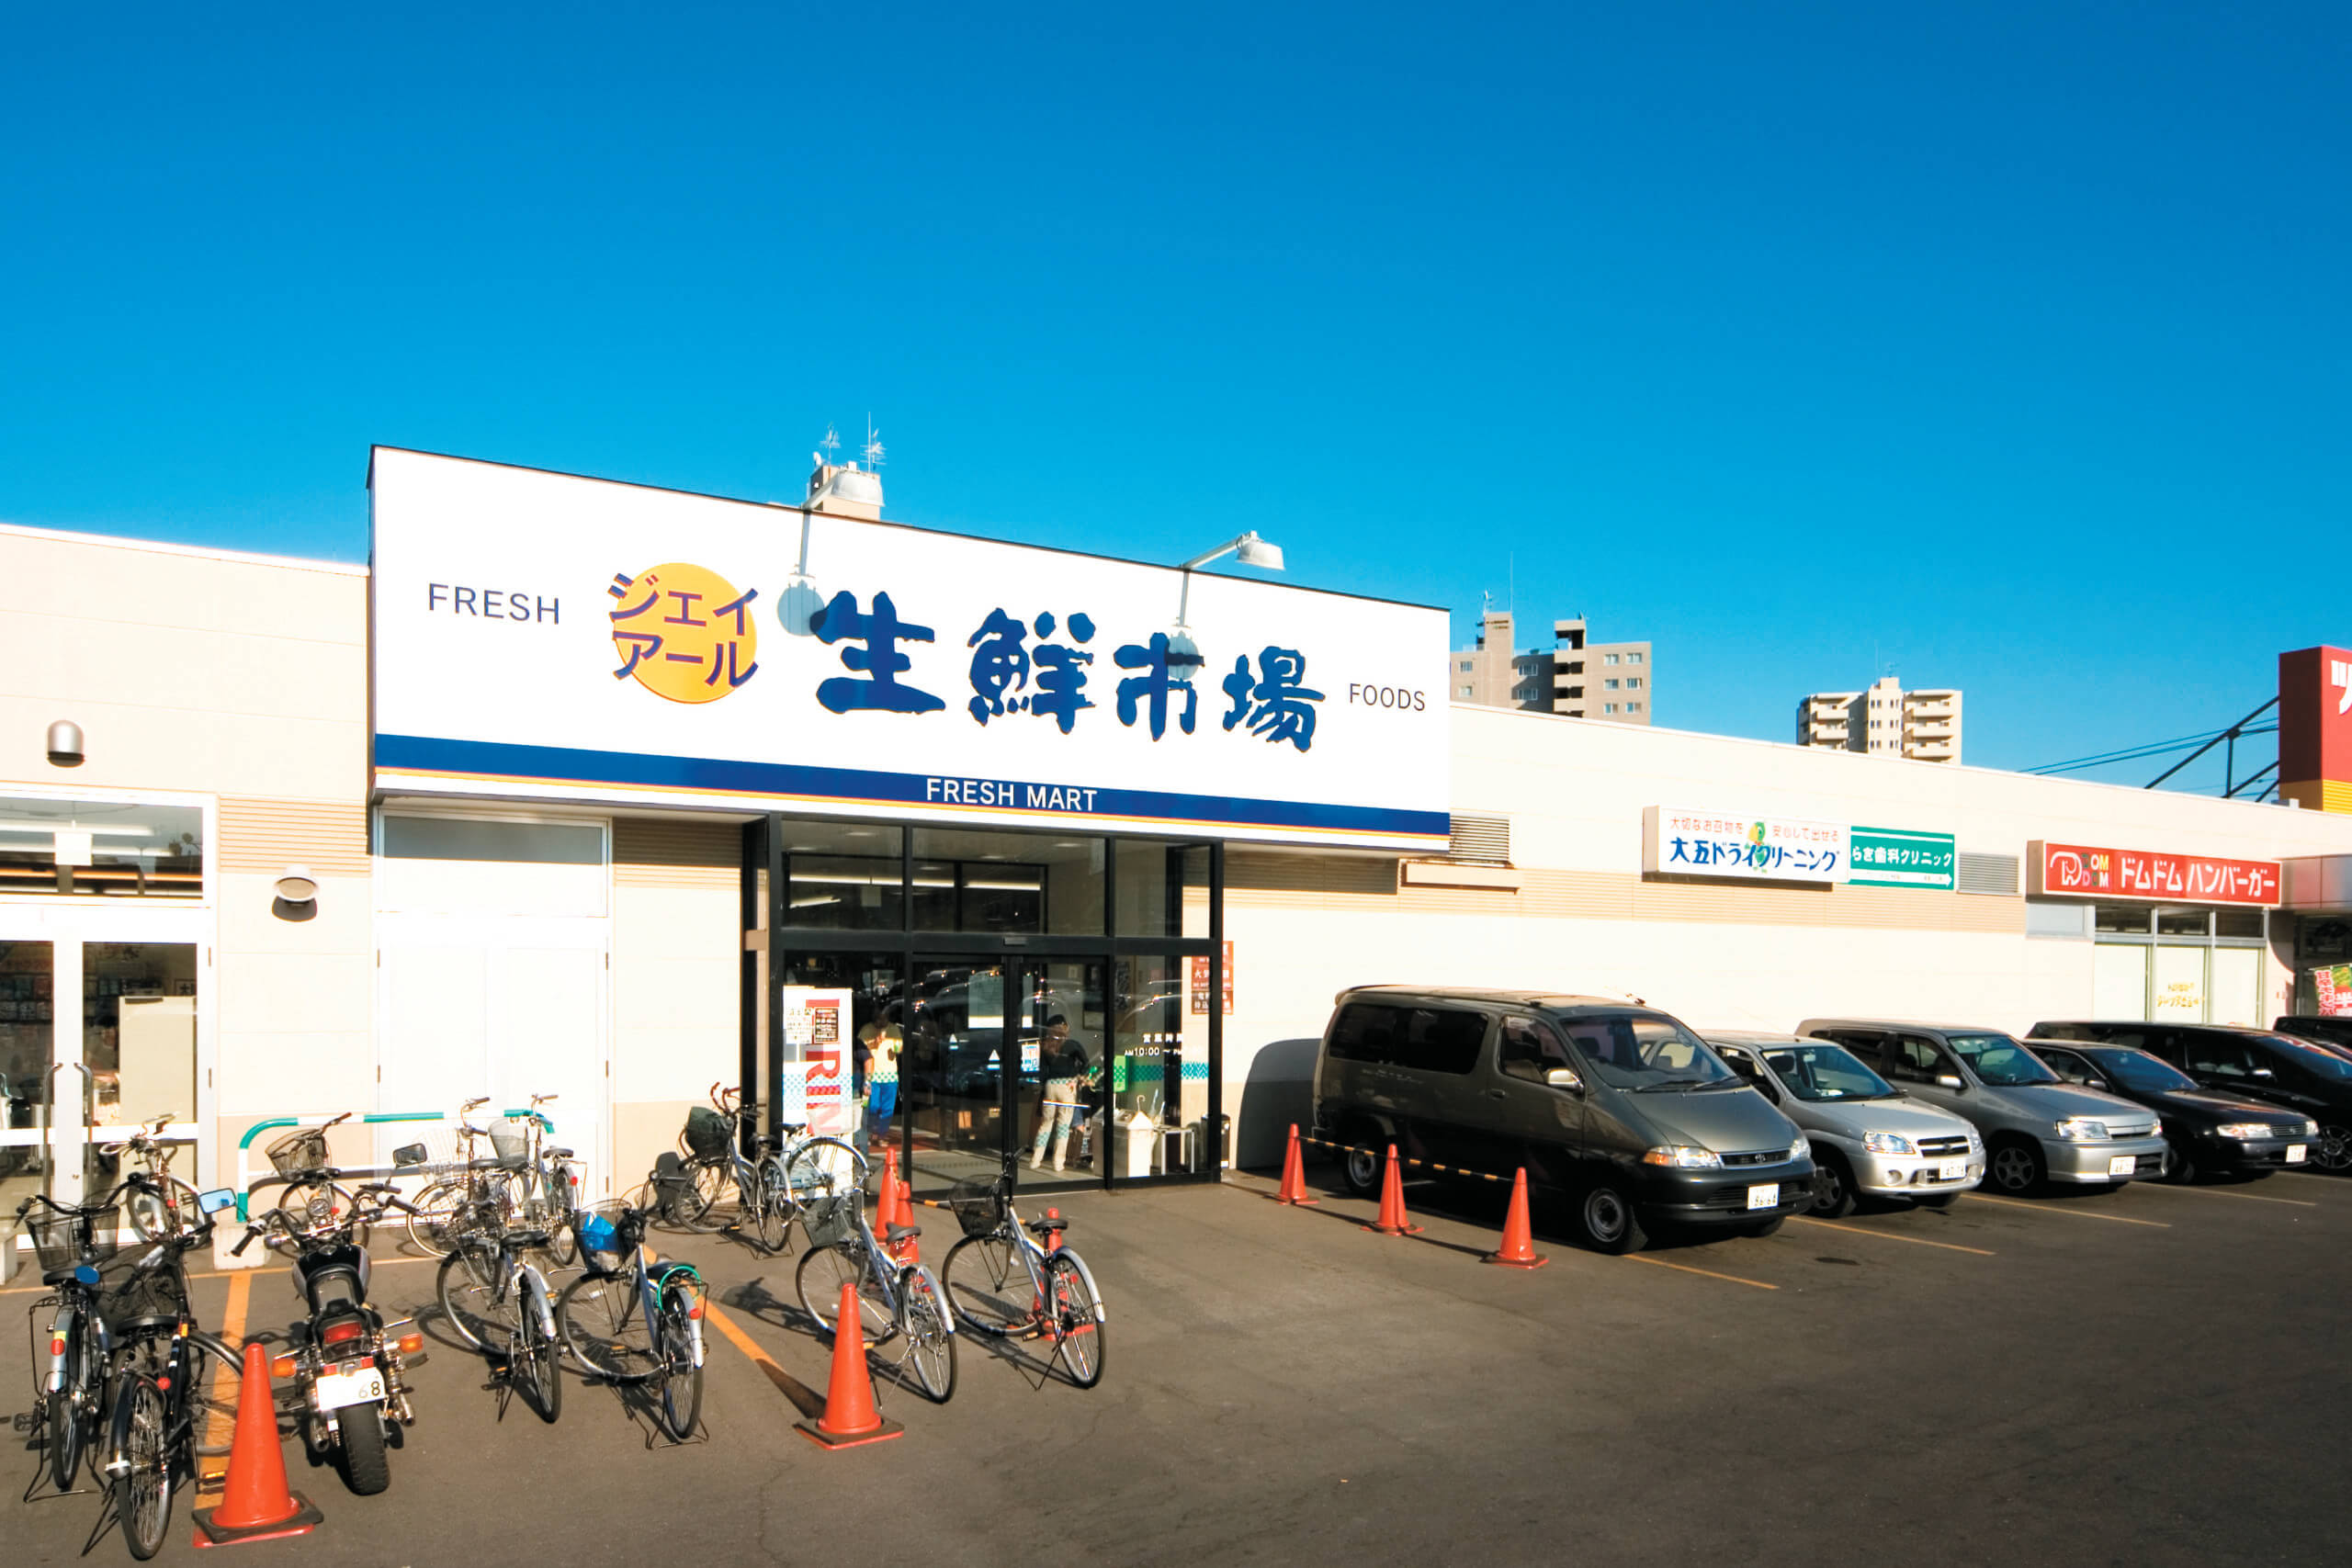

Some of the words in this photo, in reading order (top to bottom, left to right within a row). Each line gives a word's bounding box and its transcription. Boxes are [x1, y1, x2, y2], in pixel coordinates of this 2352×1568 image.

[428, 582, 560, 625] FRESH
[607, 573, 759, 636] ジェイ
[612, 631, 759, 688] アール
[809, 590, 1326, 753] 生鮮市場
[1349, 683, 1426, 712] FOODS
[926, 778, 1014, 807] FRESH
[1027, 784, 1098, 812] MART
